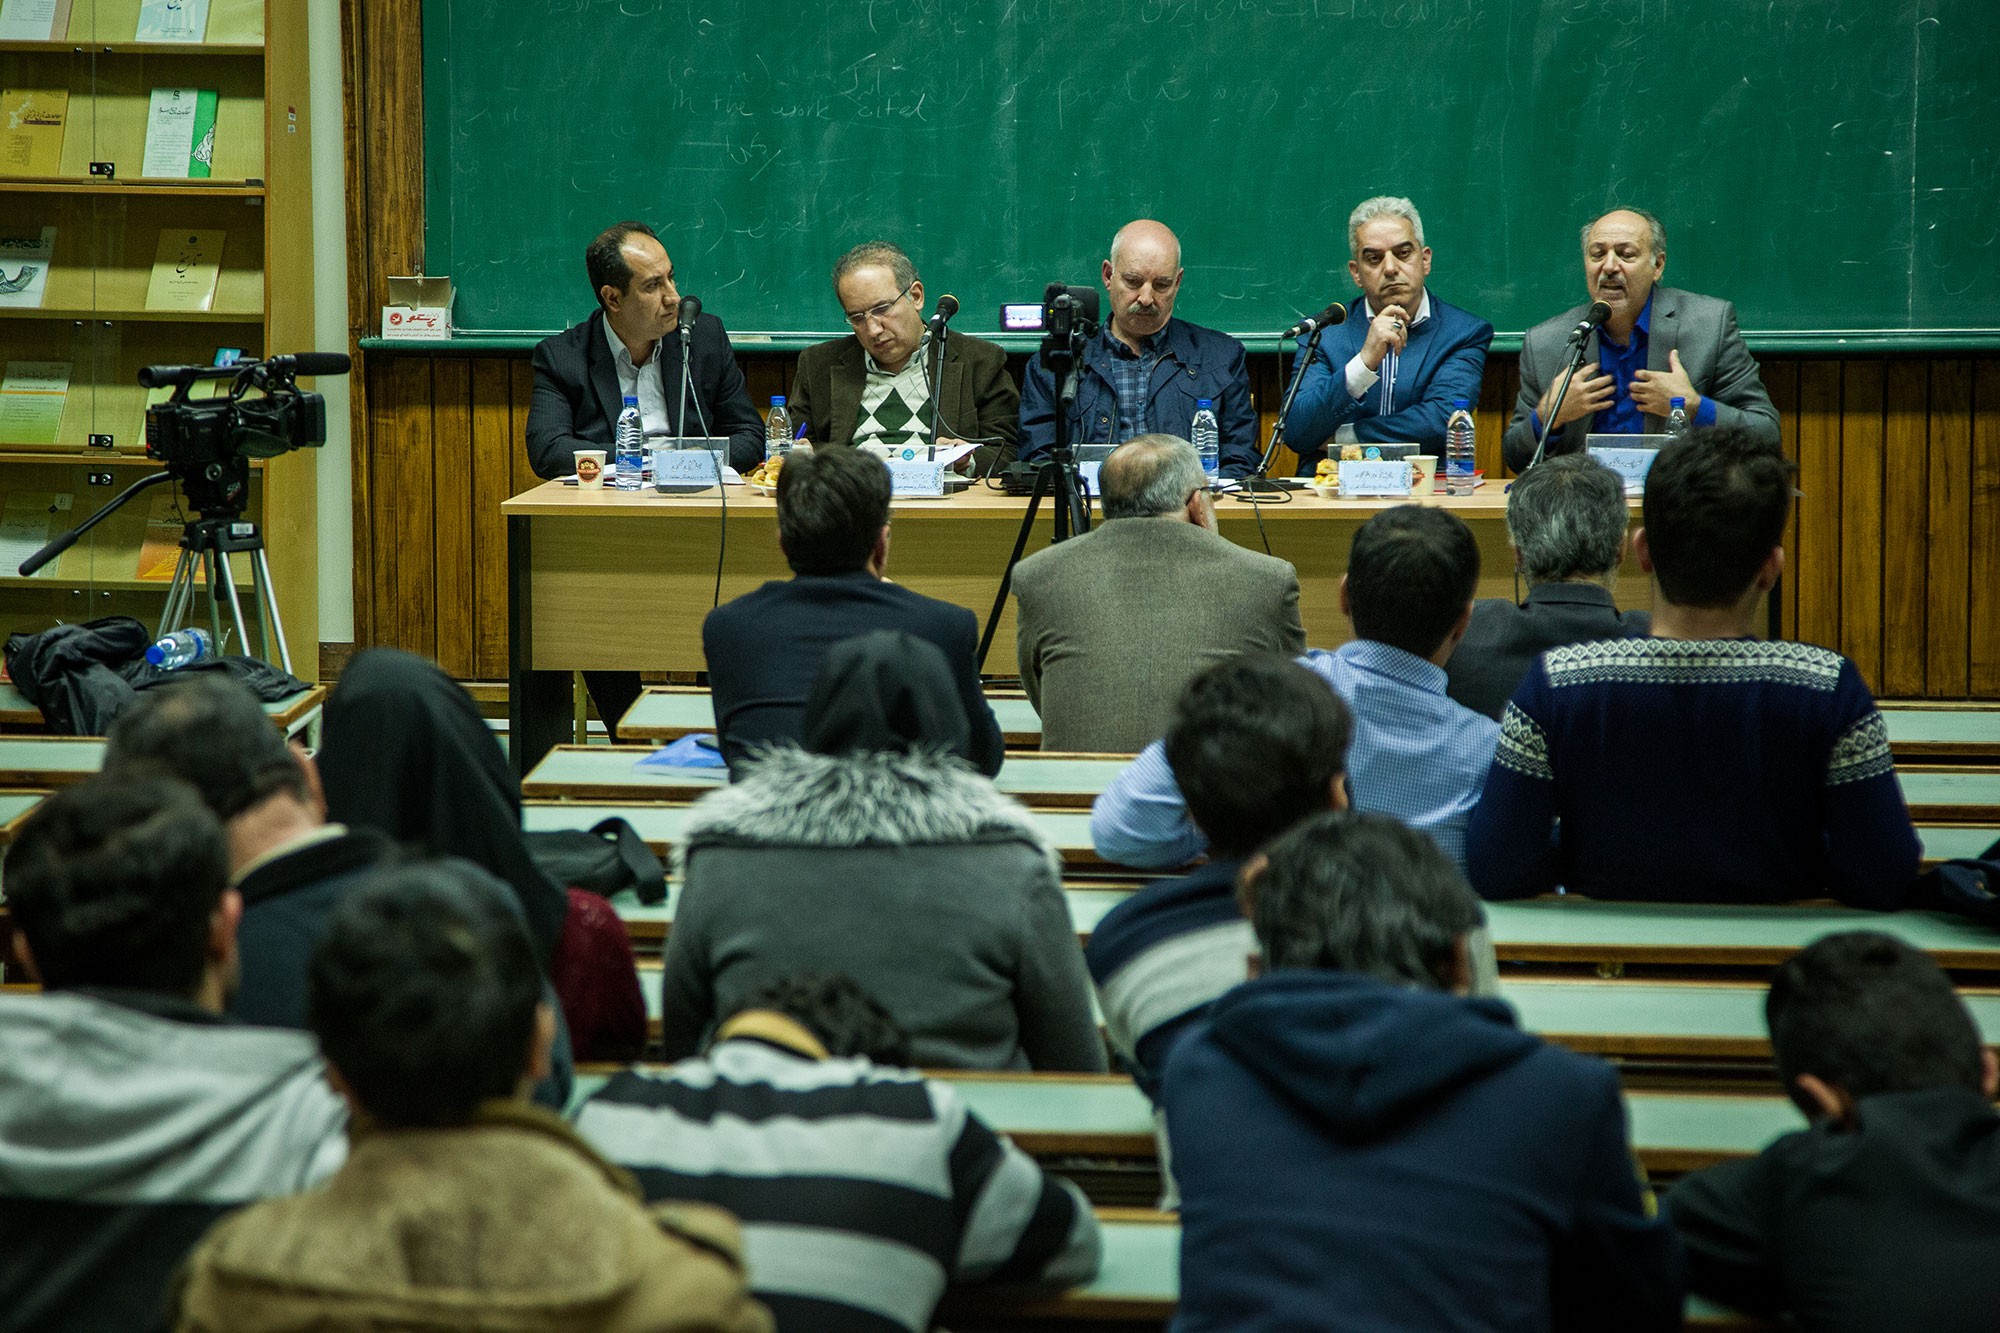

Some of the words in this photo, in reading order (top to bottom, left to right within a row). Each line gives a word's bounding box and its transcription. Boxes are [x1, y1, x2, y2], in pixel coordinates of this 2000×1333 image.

[711, 83, 756, 117] the
[771, 98, 832, 120] work
[857, 92, 929, 122] cited
[176, 252, 203, 278] تاریخ
[406, 313, 437, 328] پرستو
